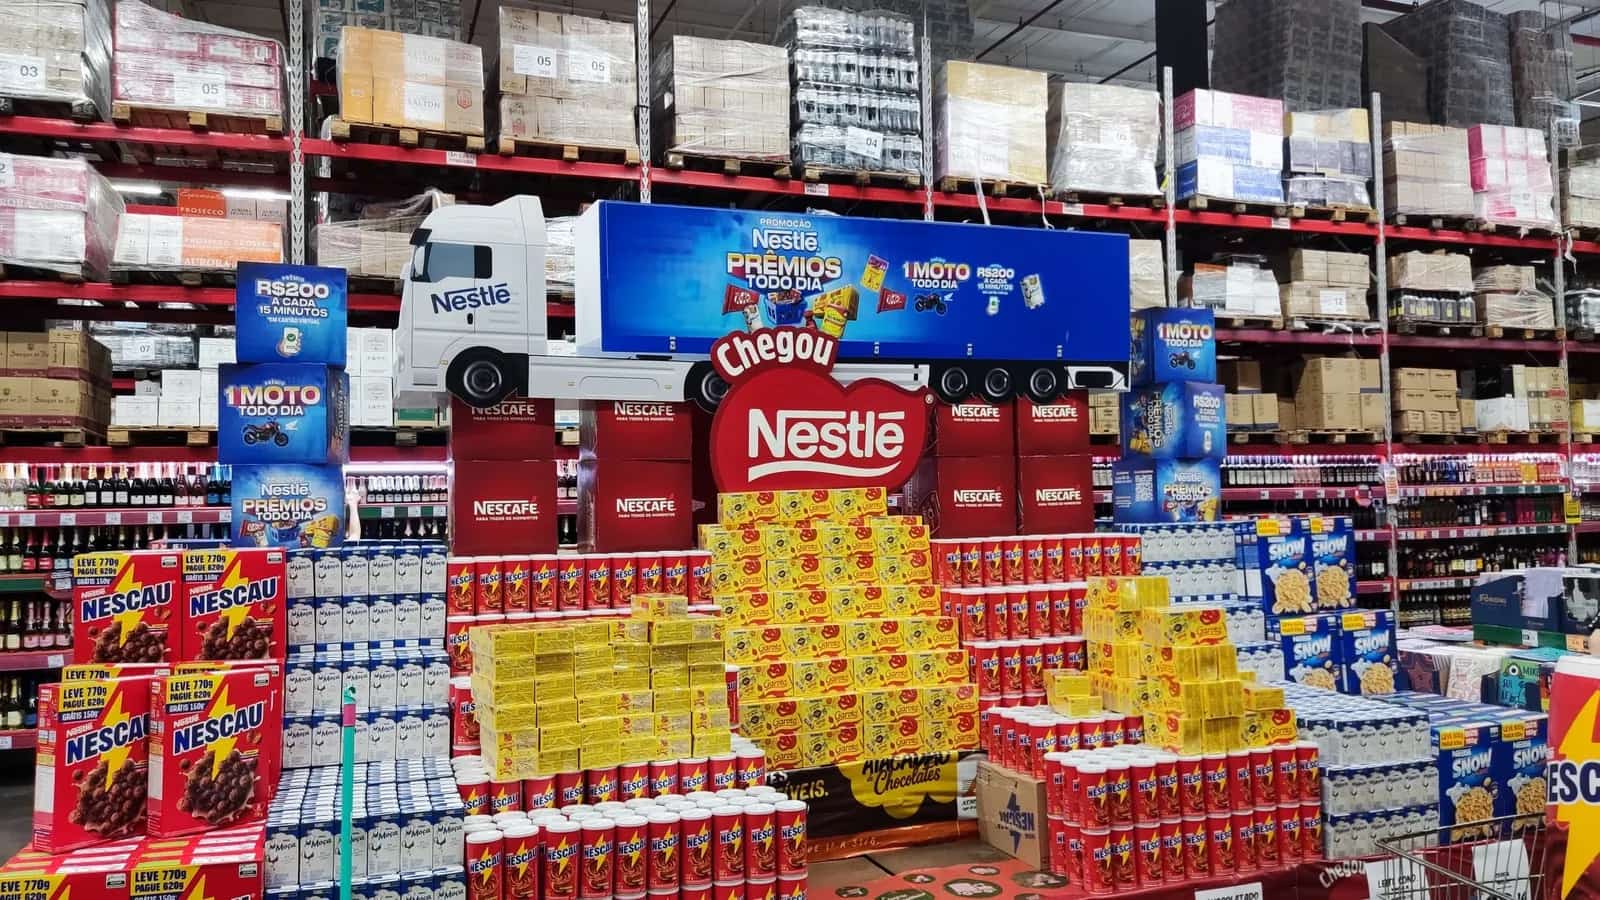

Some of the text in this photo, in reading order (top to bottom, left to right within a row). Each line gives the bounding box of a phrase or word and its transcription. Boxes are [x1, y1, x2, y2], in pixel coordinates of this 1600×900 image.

[537, 56, 551, 67] 05
[592, 61, 605, 72] 05
[20, 65, 39, 78] 03
[202, 83, 219, 96] 05
[866, 138, 878, 149] 04
[752, 229, 819, 251] Nestlé
[727, 250, 842, 279] PRÊMIOS
[914, 262, 970, 281] MOTO
[256, 280, 330, 299] R$200
[746, 275, 822, 291] TODO DIA
[912, 279, 958, 290] TODO DIA
[271, 297, 316, 307] A CADA
[431, 283, 511, 314] Nestlé
[259, 306, 328, 318] 15 MINUTOS
[1167, 324, 1212, 340] MOTO
[140, 345, 151, 353] 07
[716, 331, 834, 377] Chegou
[239, 385, 321, 406] MOTO
[239, 406, 304, 416] TODO DIA
[748, 409, 905, 459] Nestlé
[261, 483, 310, 496] Nestlé
[242, 496, 327, 513] PRÊMIOS
[256, 511, 313, 521] TODO DIA
[77, 557, 119, 568] LEVE 770g
[185, 553, 226, 564] LEVE 770g
[77, 568, 99, 576] PAGUE
[185, 564, 206, 572] PAGUE
[82, 582, 172, 622] NESCAU
[190, 577, 277, 617] NESCAU
[65, 671, 86, 679] LEVE
[170, 679, 213, 691] LEVE 770g
[63, 687, 107, 699] LEVE 770g
[170, 689, 211, 701] PAGUE 620g
[63, 697, 105, 709] PAGUE 620g
[173, 702, 264, 755] NESCAU
[1452, 748, 1493, 778] SNOW
[874, 767, 941, 795] Chocolates
[1548, 761, 1600, 804] ESC
[720, 828, 744, 844] NESC
[782, 825, 805, 839] NESC
[135, 870, 187, 883] LEVE 770g
[0, 879, 50, 892] EVE 770g
[135, 882, 184, 893] PAGUE 620g
